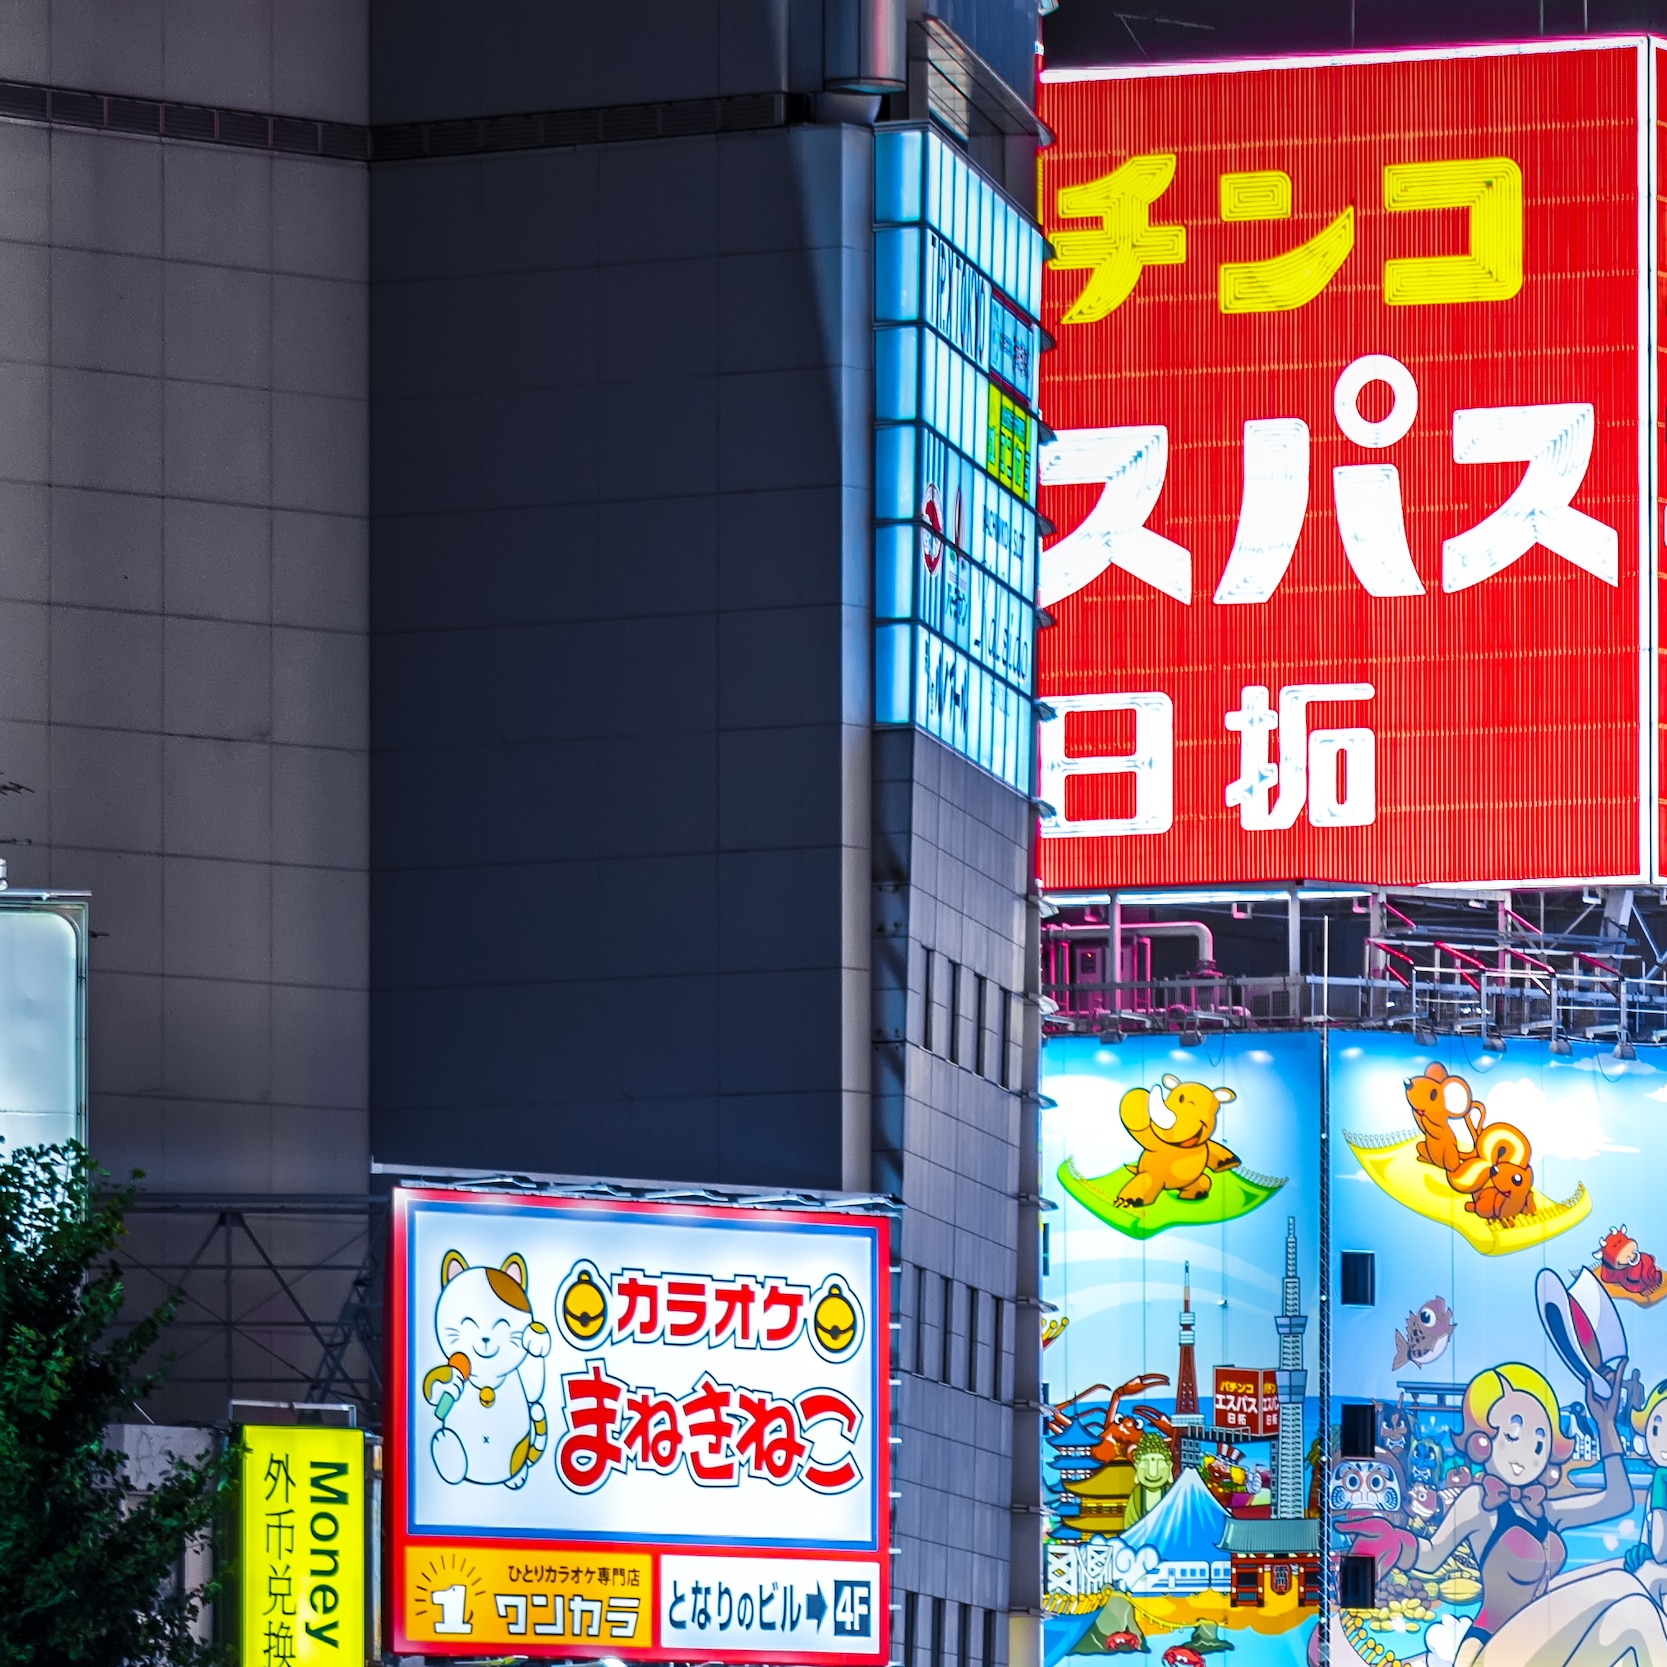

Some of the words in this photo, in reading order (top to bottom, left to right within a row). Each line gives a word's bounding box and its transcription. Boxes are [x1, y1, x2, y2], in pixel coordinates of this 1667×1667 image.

[1041, 354, 1620, 606] スパス
[1041, 682, 1377, 837] 日拓
[615, 1280, 804, 1345] カラオケ
[1215, 1393, 1258, 1414] エスパス
[1219, 1380, 1255, 1394] パチンコ
[560, 1360, 864, 1491] まねきねこ
[1227, 1413, 1247, 1426] 日拓
[307, 1460, 350, 1650] Money
[506, 1564, 643, 1588] ひとりカラオケ専門店
[493, 1591, 643, 1640] ワンカラ
[667, 1578, 803, 1630] となりのビル
[834, 1581, 871, 1637] 4F
